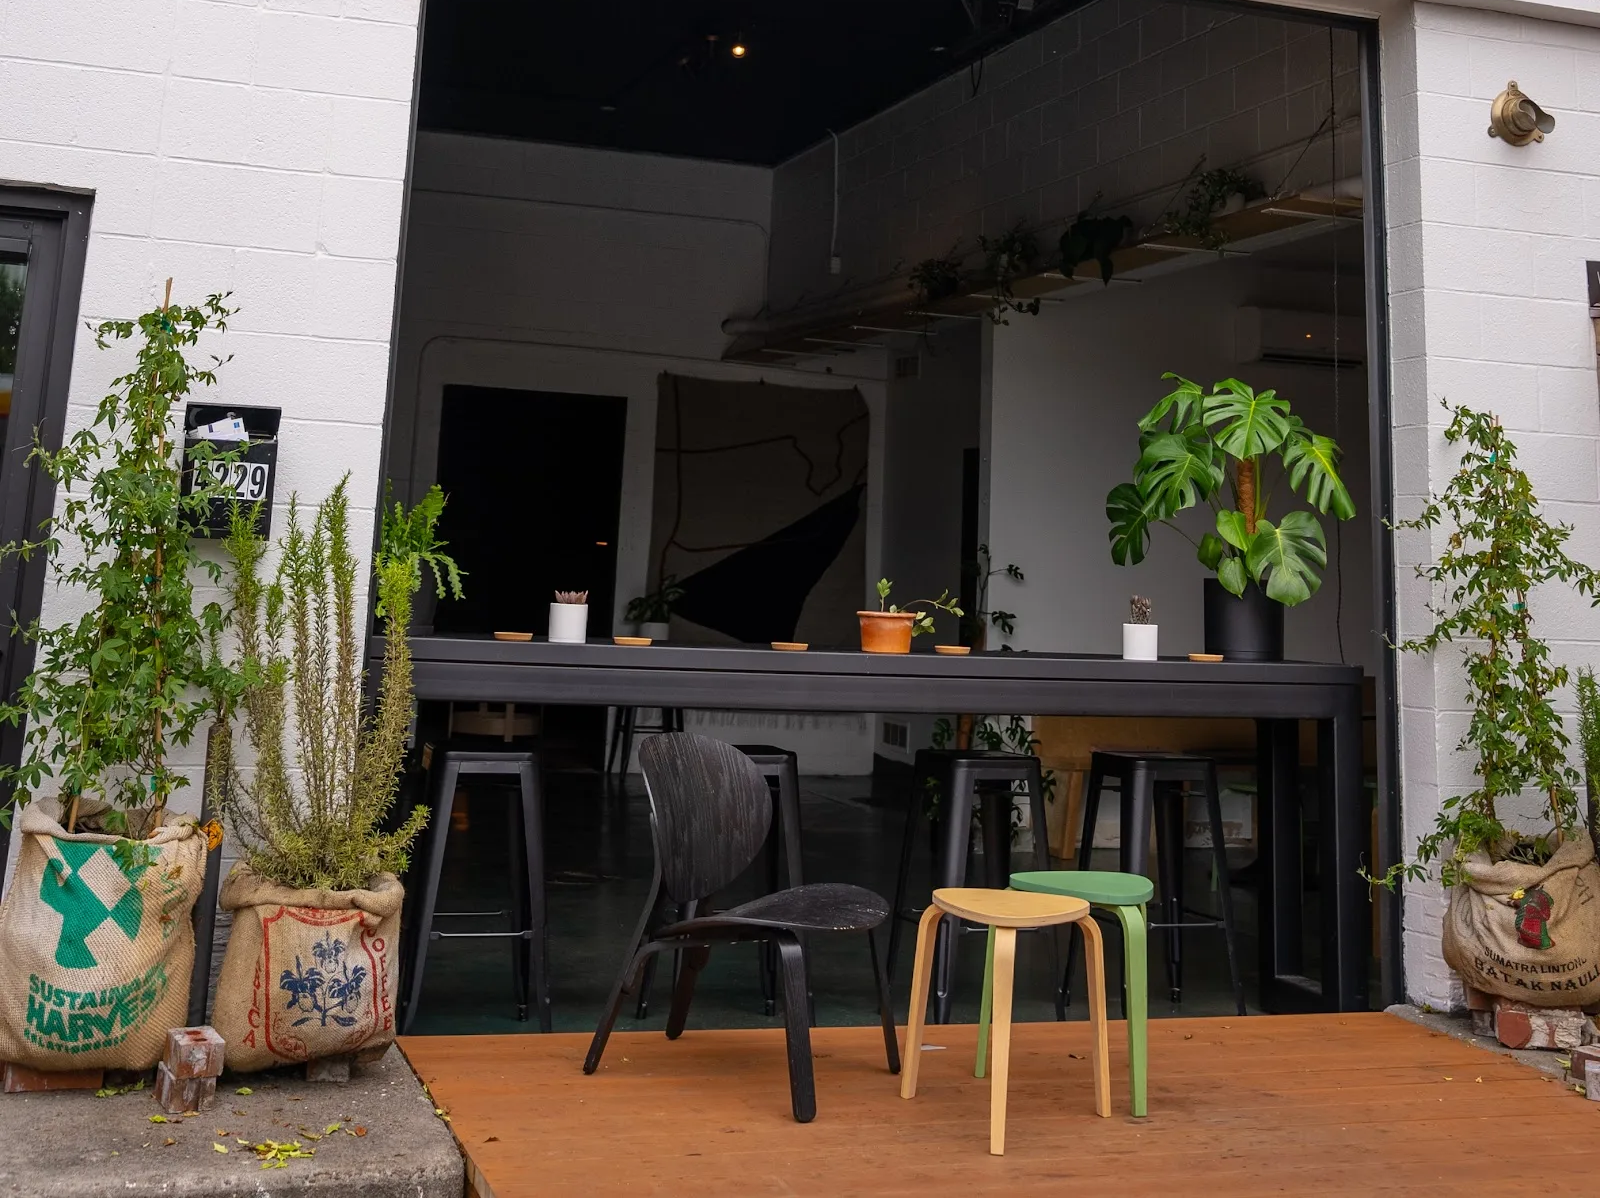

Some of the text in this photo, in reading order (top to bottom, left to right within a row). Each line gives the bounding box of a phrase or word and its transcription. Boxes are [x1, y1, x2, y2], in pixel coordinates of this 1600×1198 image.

[194, 461, 266, 498] 4229
[1474, 956, 1545, 991] BATAK
[1484, 946, 1538, 974] SUMATRA
